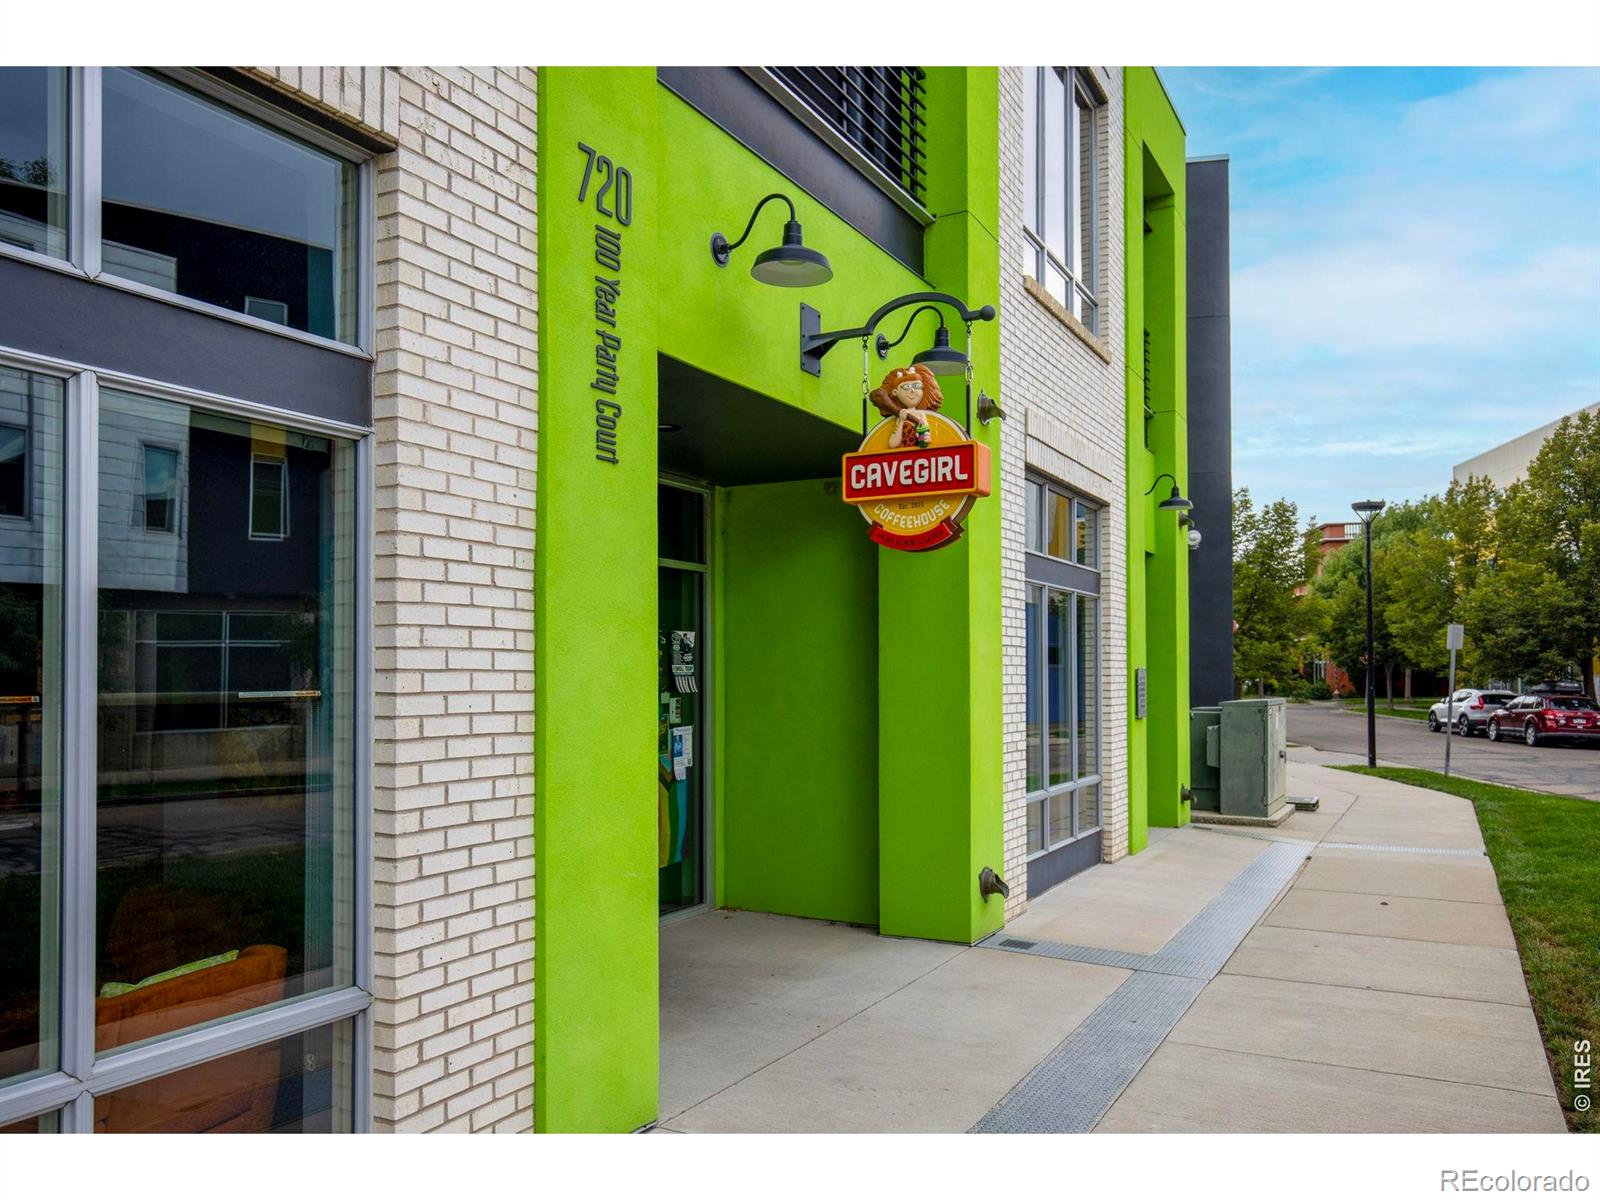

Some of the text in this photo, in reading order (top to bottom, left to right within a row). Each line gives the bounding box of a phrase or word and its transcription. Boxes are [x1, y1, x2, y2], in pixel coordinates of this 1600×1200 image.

[578, 141, 632, 226] 720
[590, 224, 622, 465] 100 Year Party Court
[851, 455, 968, 489] CAVEGIRL
[874, 499, 950, 528] COFFEEHOUSE
